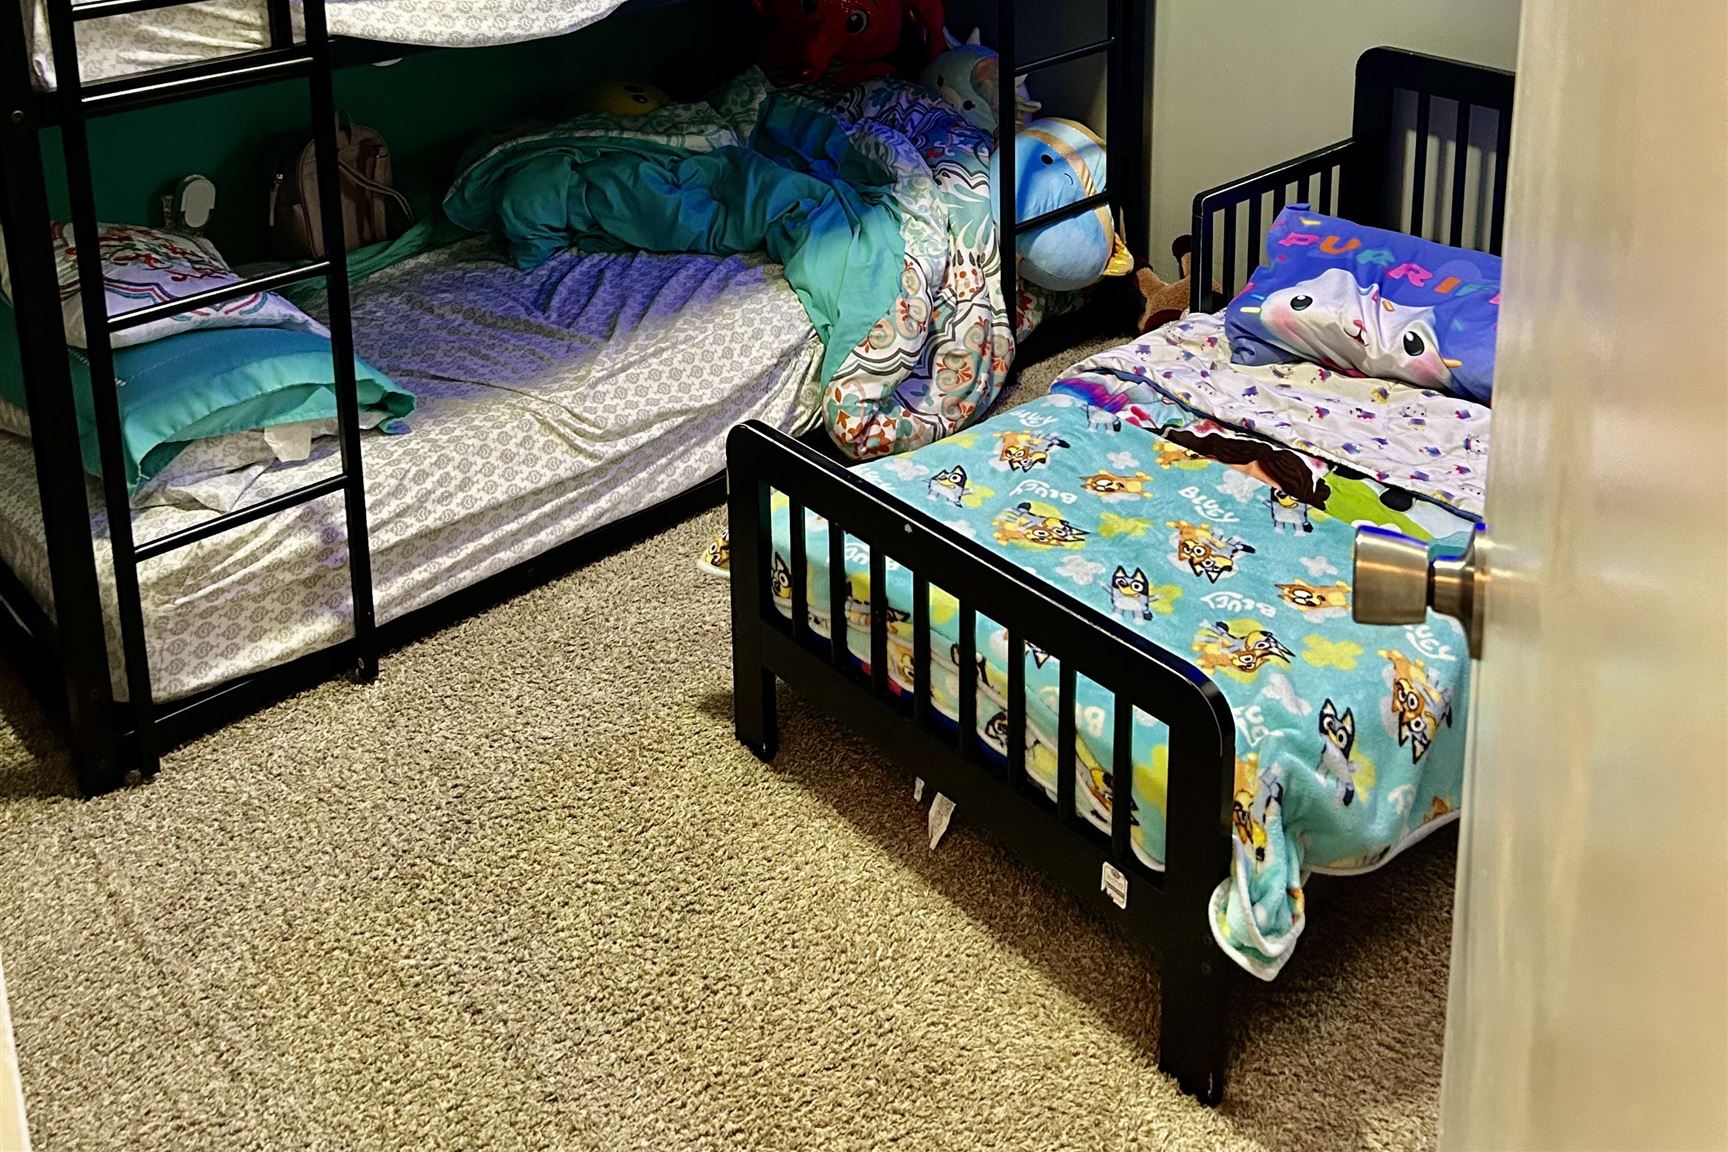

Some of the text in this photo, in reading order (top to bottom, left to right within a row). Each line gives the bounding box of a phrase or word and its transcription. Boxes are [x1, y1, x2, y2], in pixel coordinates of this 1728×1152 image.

[1009, 479, 1078, 505] BLUEY
[1177, 486, 1241, 523] BLUEY
[1200, 591, 1277, 619] BLUEY
